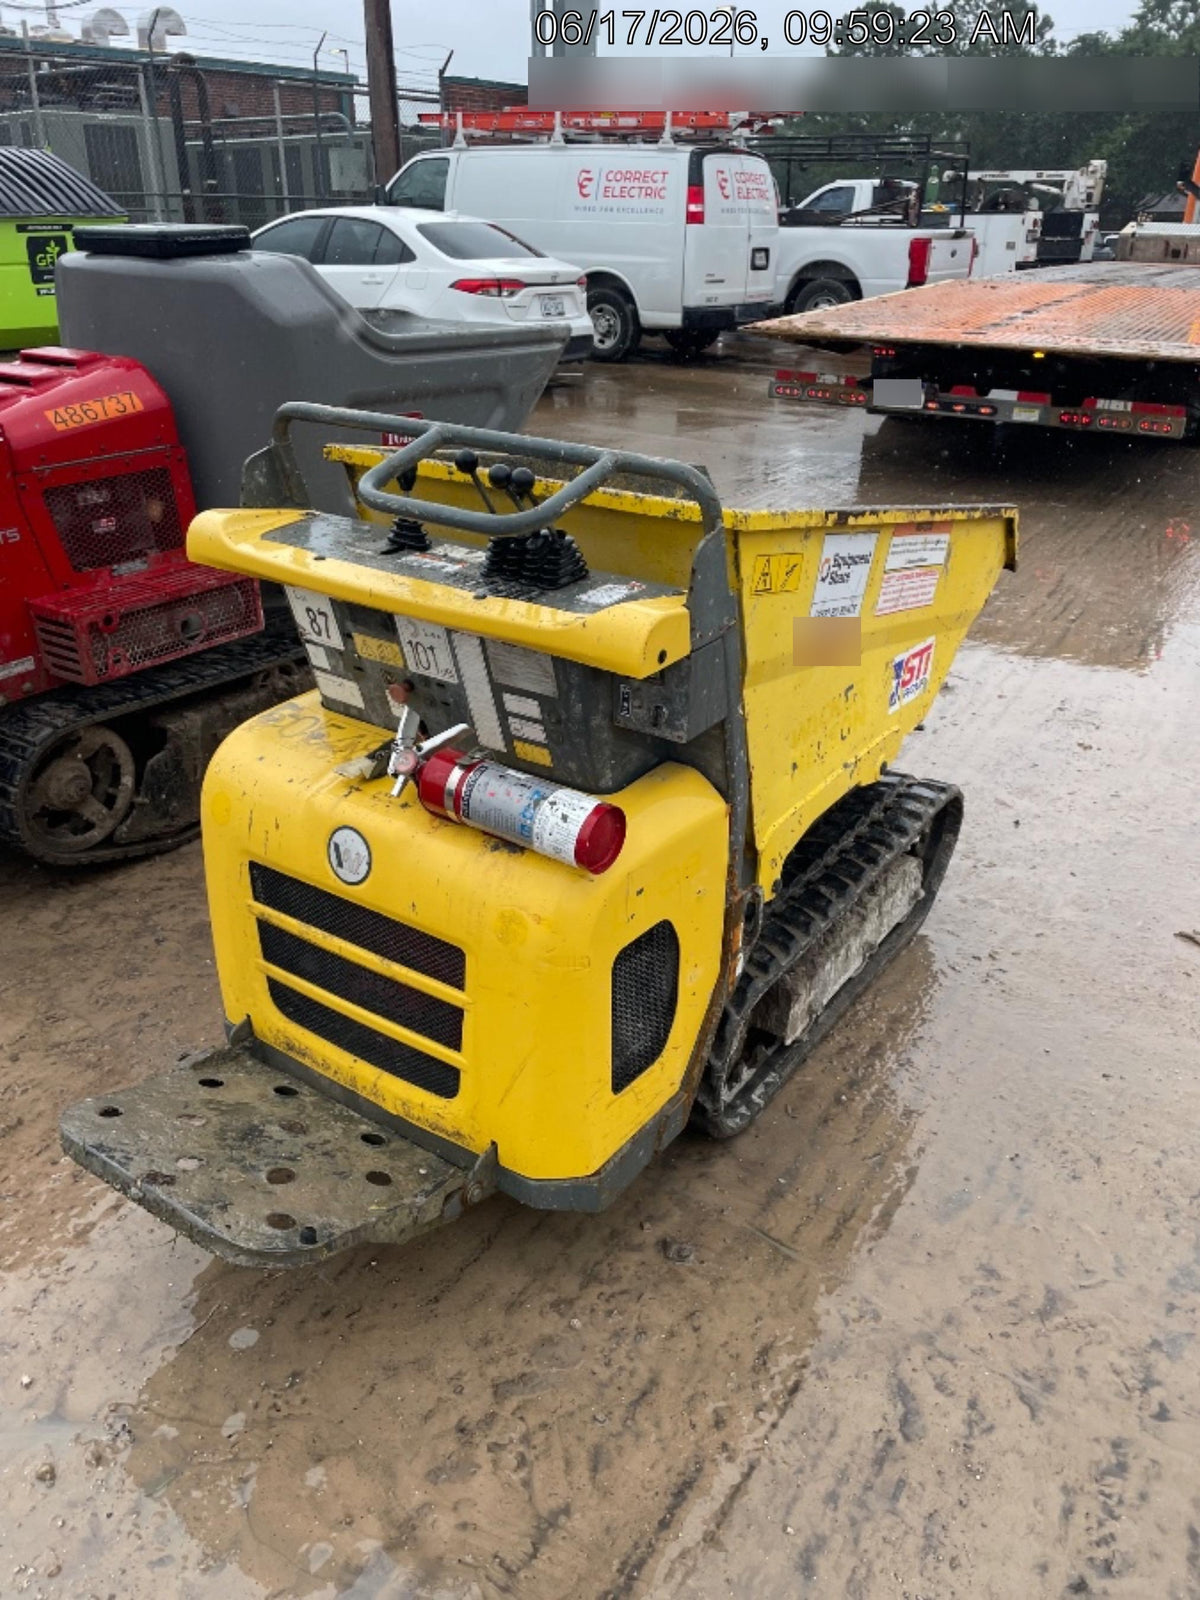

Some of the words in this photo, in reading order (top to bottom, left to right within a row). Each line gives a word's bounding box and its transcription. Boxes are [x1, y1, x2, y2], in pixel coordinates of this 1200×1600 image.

[605, 169, 669, 184] CORRECT
[733, 170, 767, 185] CORRECT
[602, 186, 666, 199] ELECTRIC
[736, 186, 770, 201] ELECTRIC
[53, 392, 138, 428] 486737
[305, 606, 331, 640] 87
[407, 639, 440, 672] 101
